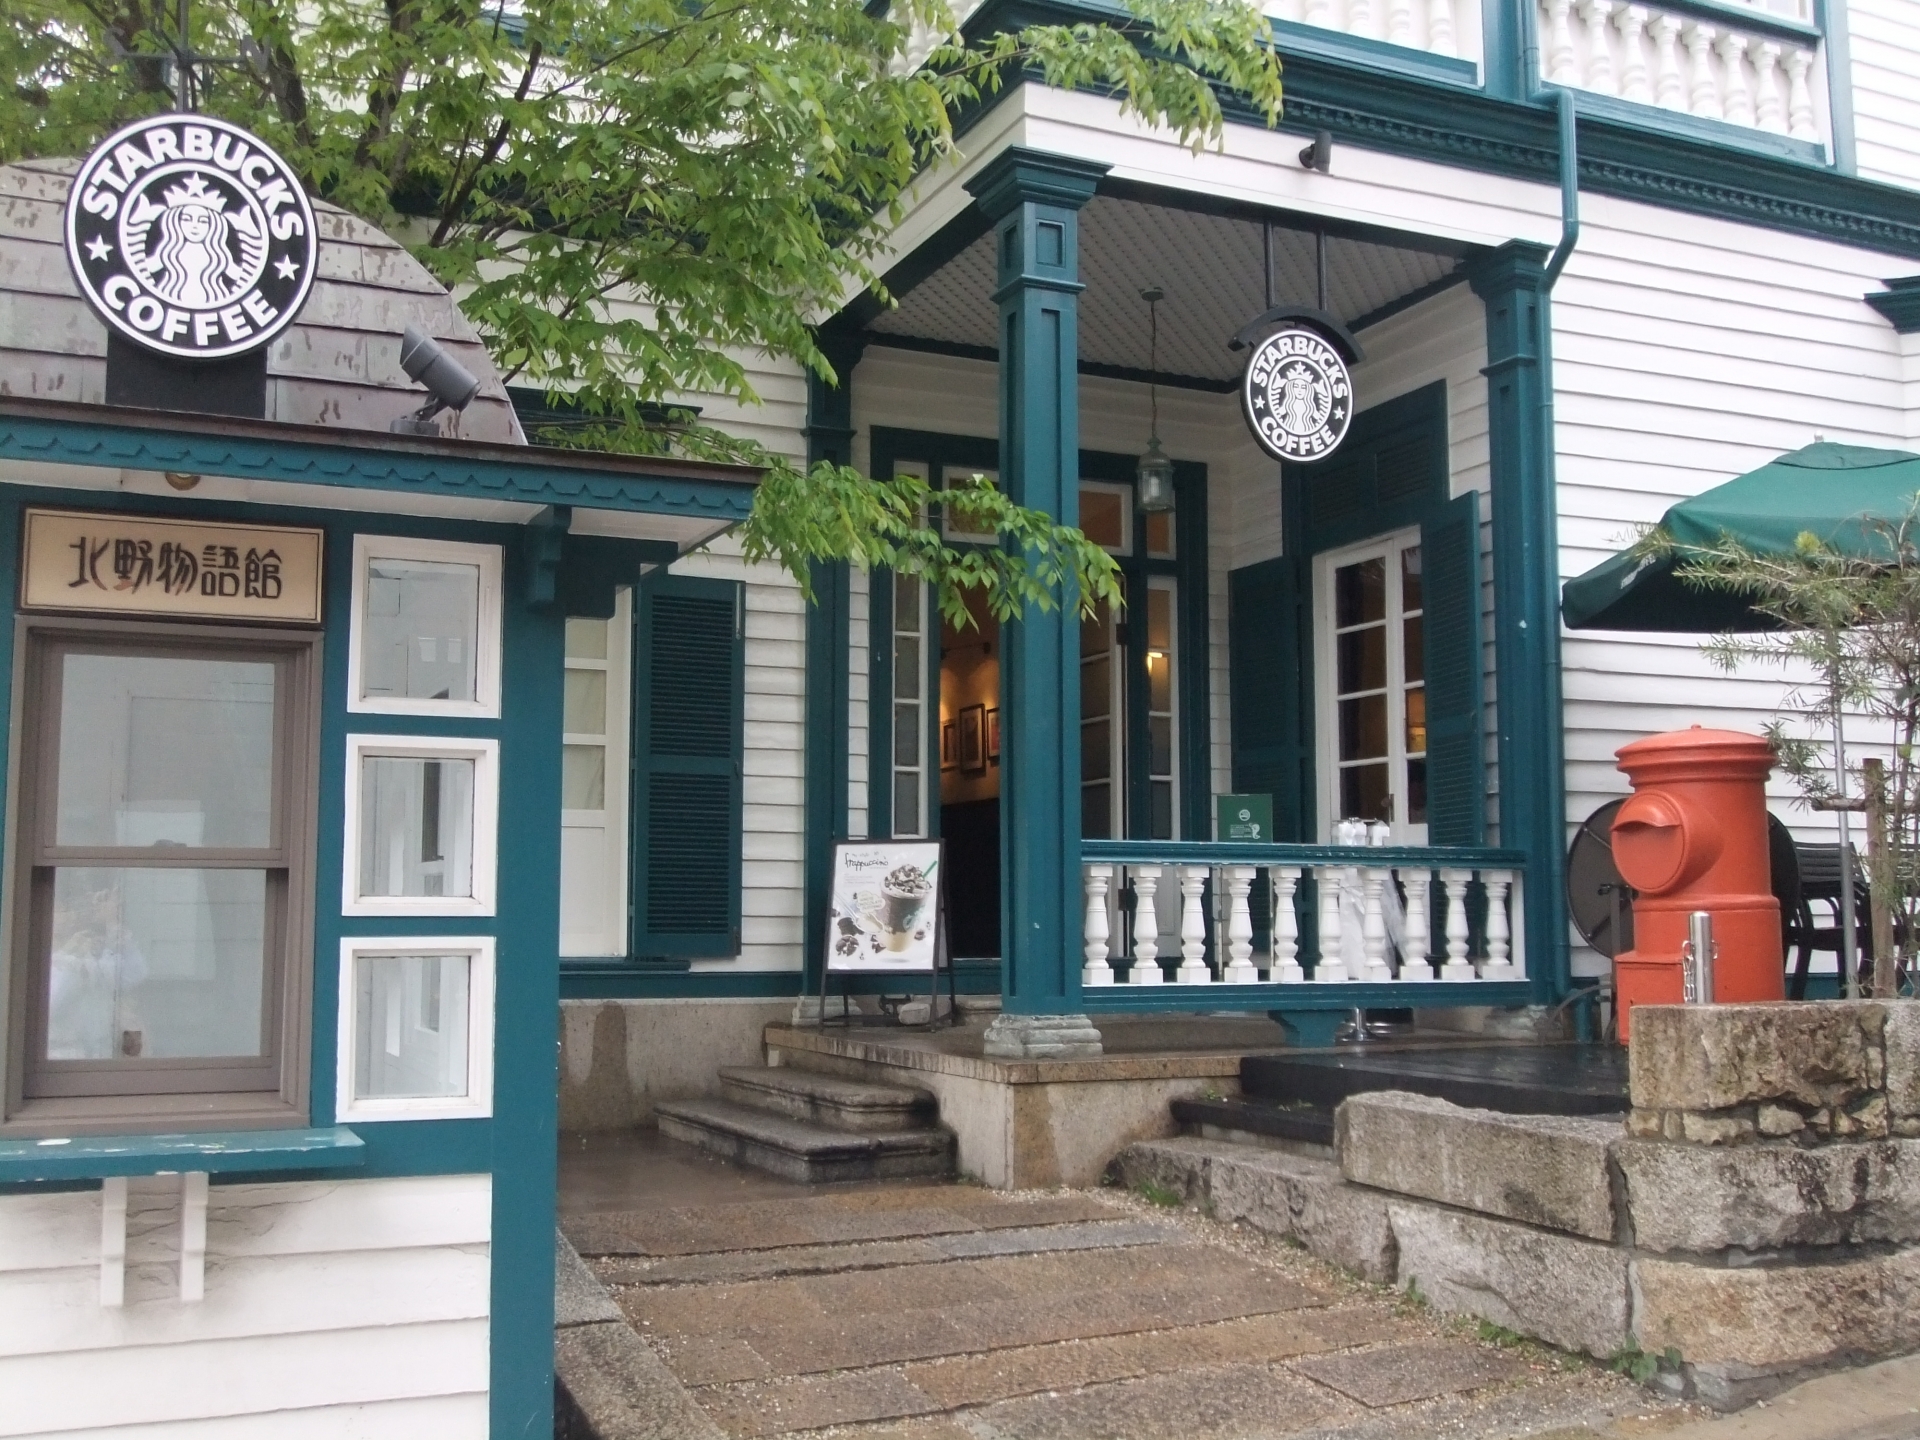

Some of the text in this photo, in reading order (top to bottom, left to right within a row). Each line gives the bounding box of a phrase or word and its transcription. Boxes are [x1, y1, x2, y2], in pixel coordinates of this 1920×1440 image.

[83, 126, 304, 241] STARBUCKS
[103, 275, 279, 346] COFFEE
[1252, 337, 1348, 399] STARBUCKS
[1261, 416, 1336, 455] COFFEE
[68, 536, 283, 600] 北野物語館
